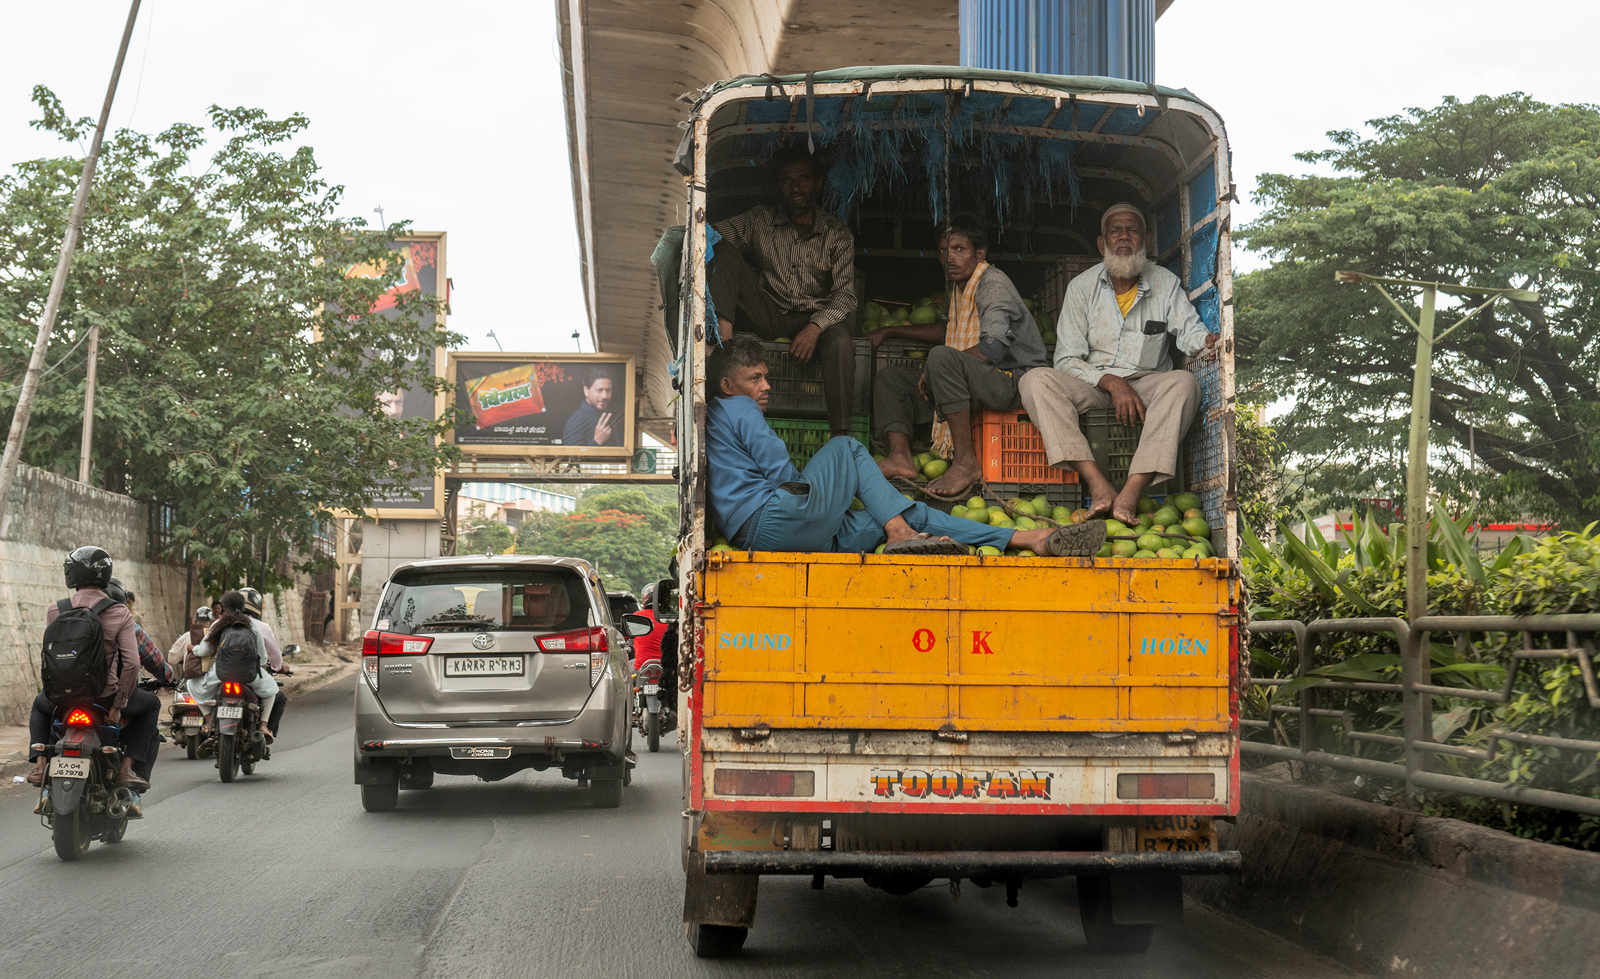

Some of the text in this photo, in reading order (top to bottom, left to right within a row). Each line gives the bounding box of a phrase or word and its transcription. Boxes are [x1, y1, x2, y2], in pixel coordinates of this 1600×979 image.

[718, 628, 1209, 656] SOUND O K HORN
[870, 767, 1055, 801] TOOFAN
[1145, 814, 1201, 831] KA03
[710, 833, 773, 848] Signal
